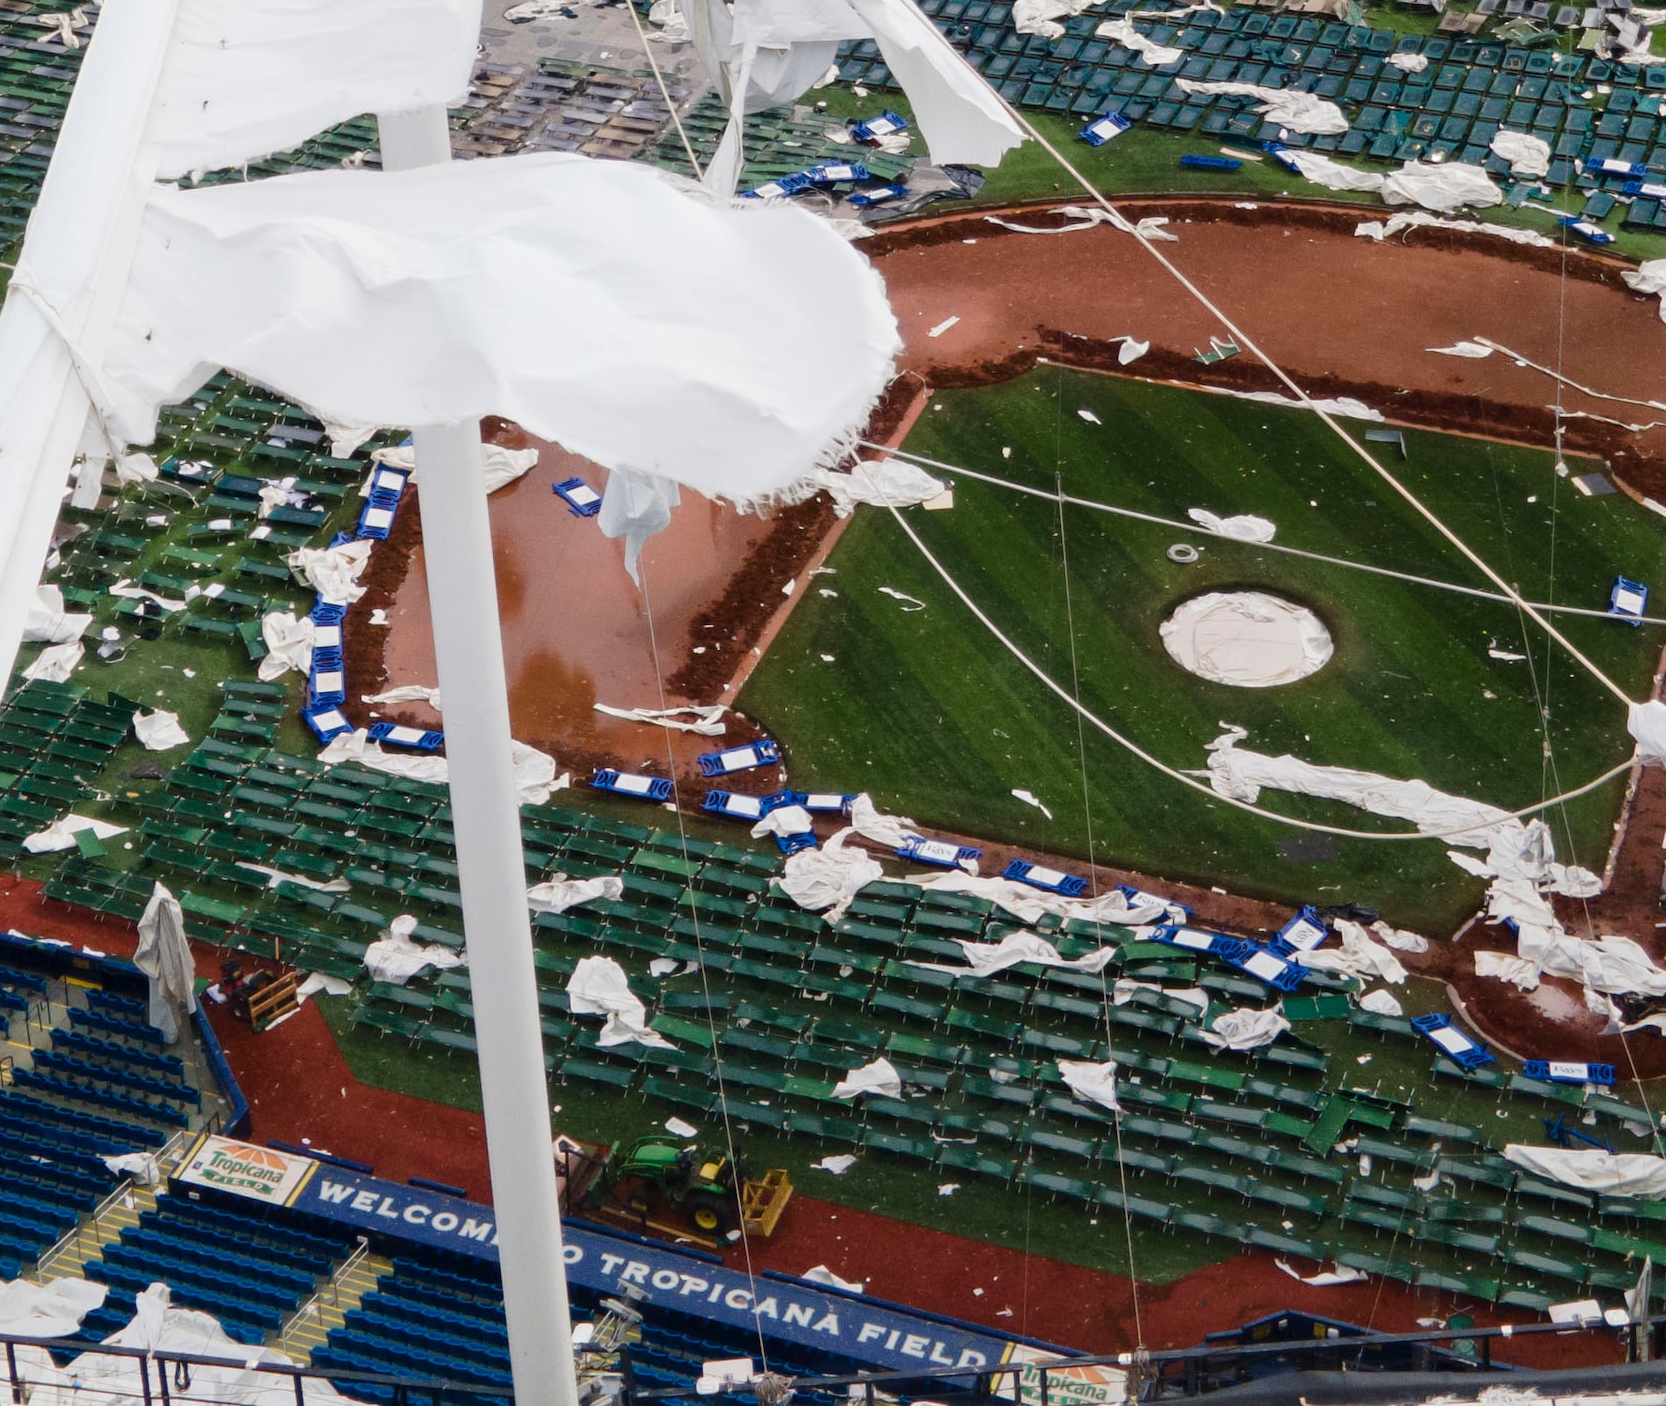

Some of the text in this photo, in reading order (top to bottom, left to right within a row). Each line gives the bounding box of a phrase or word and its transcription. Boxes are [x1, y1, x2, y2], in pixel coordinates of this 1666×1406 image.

[207, 1149, 284, 1185] Tropicana
[211, 1173, 265, 1191] FIELD
[317, 1179, 989, 1370] WELCOM O TROPICANA FIELD
[1021, 1362, 1108, 1401] Trpicana
